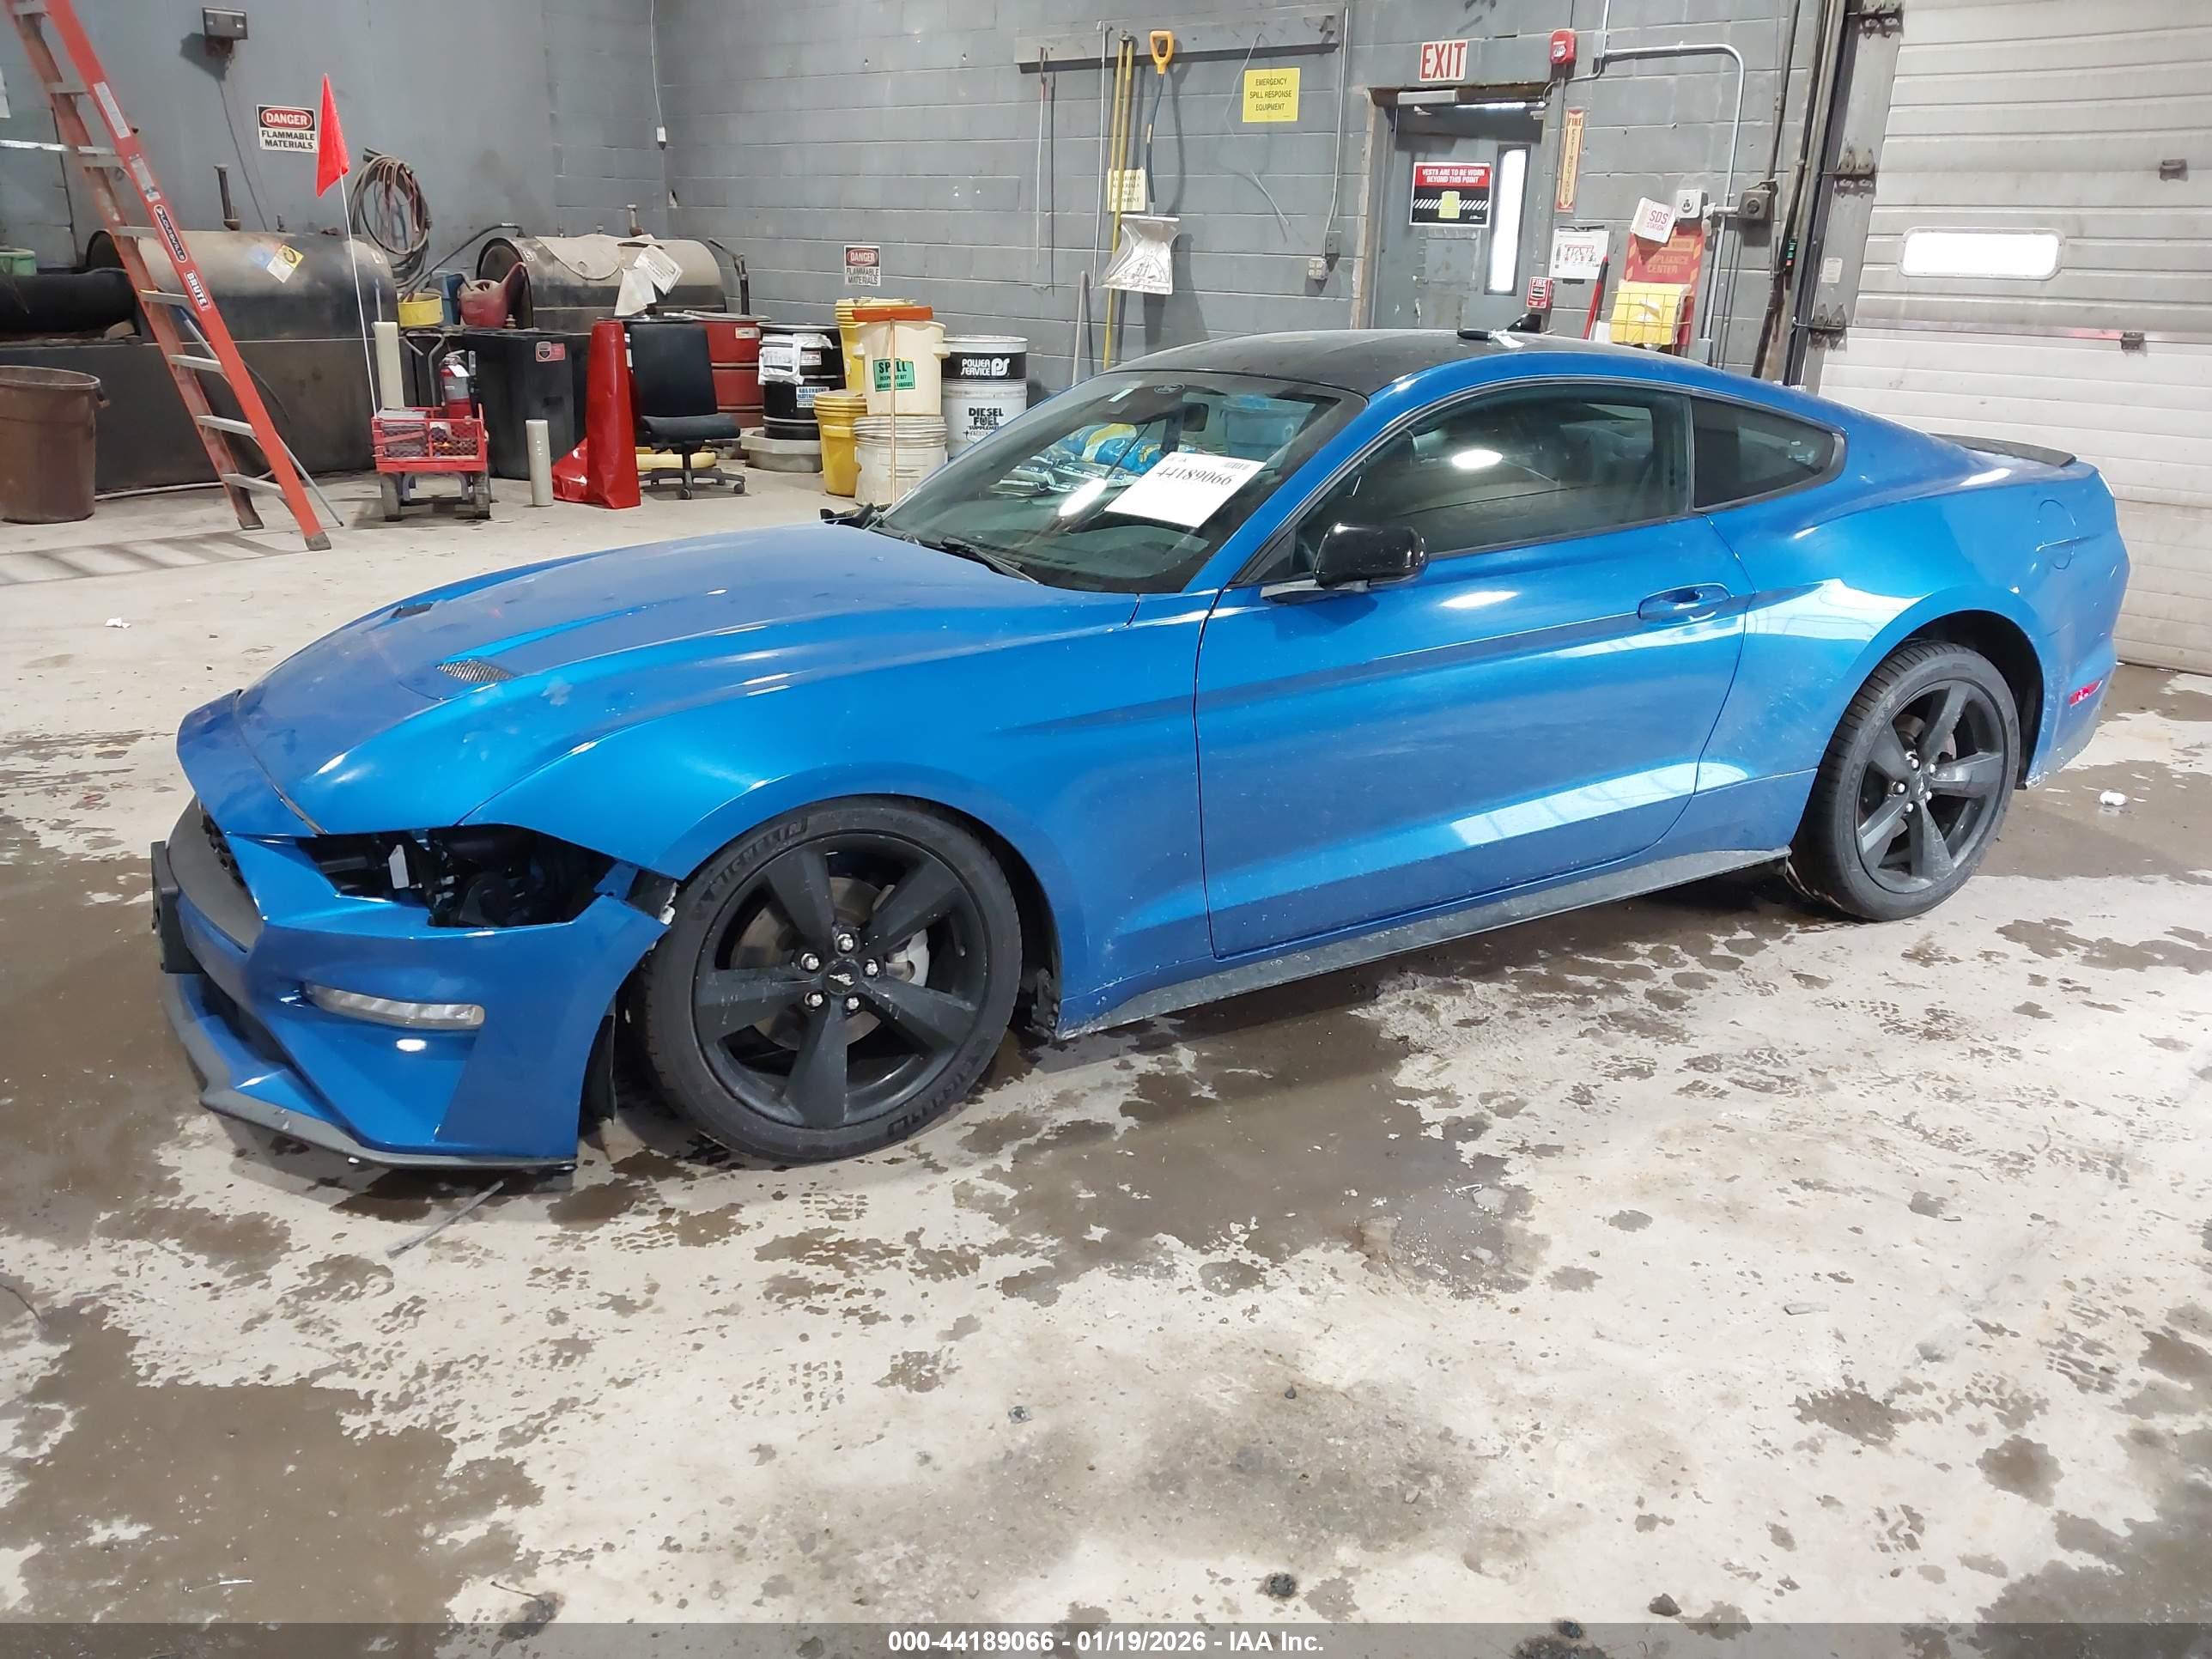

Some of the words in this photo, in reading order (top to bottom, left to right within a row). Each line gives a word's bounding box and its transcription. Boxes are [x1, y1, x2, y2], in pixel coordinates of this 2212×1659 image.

[1421, 42, 1466, 78] EXIT
[1255, 77, 1288, 86] EMERGENCY
[1249, 90, 1264, 99] SPILL
[1265, 89, 1292, 98] RESPONSE
[1255, 102, 1285, 111] EQUIPMENT
[265, 112, 307, 125] DANGER
[1567, 117, 1583, 126] FIRE
[261, 130, 315, 141] FLAMMABLE
[264, 139, 313, 149] MATERIALS
[1426, 175, 1449, 184] BEYOND
[1649, 210, 1668, 225] SDS
[1647, 222, 1665, 232] STATION
[850, 252, 875, 262] DANGER
[846, 267, 880, 276] FLAMMABLE
[1648, 264, 1679, 274] CENTER
[848, 275, 878, 285] MATERIALS
[185, 271, 209, 307] BRUTE
[878, 361, 907, 374] SPLL
[962, 358, 990, 368] POWER
[991, 357, 1010, 376] PS
[960, 367, 991, 376] SERVICE
[969, 407, 1004, 417] DIESEL
[974, 416, 1000, 426] FUEL
[1156, 466, 1237, 486] 44189066
